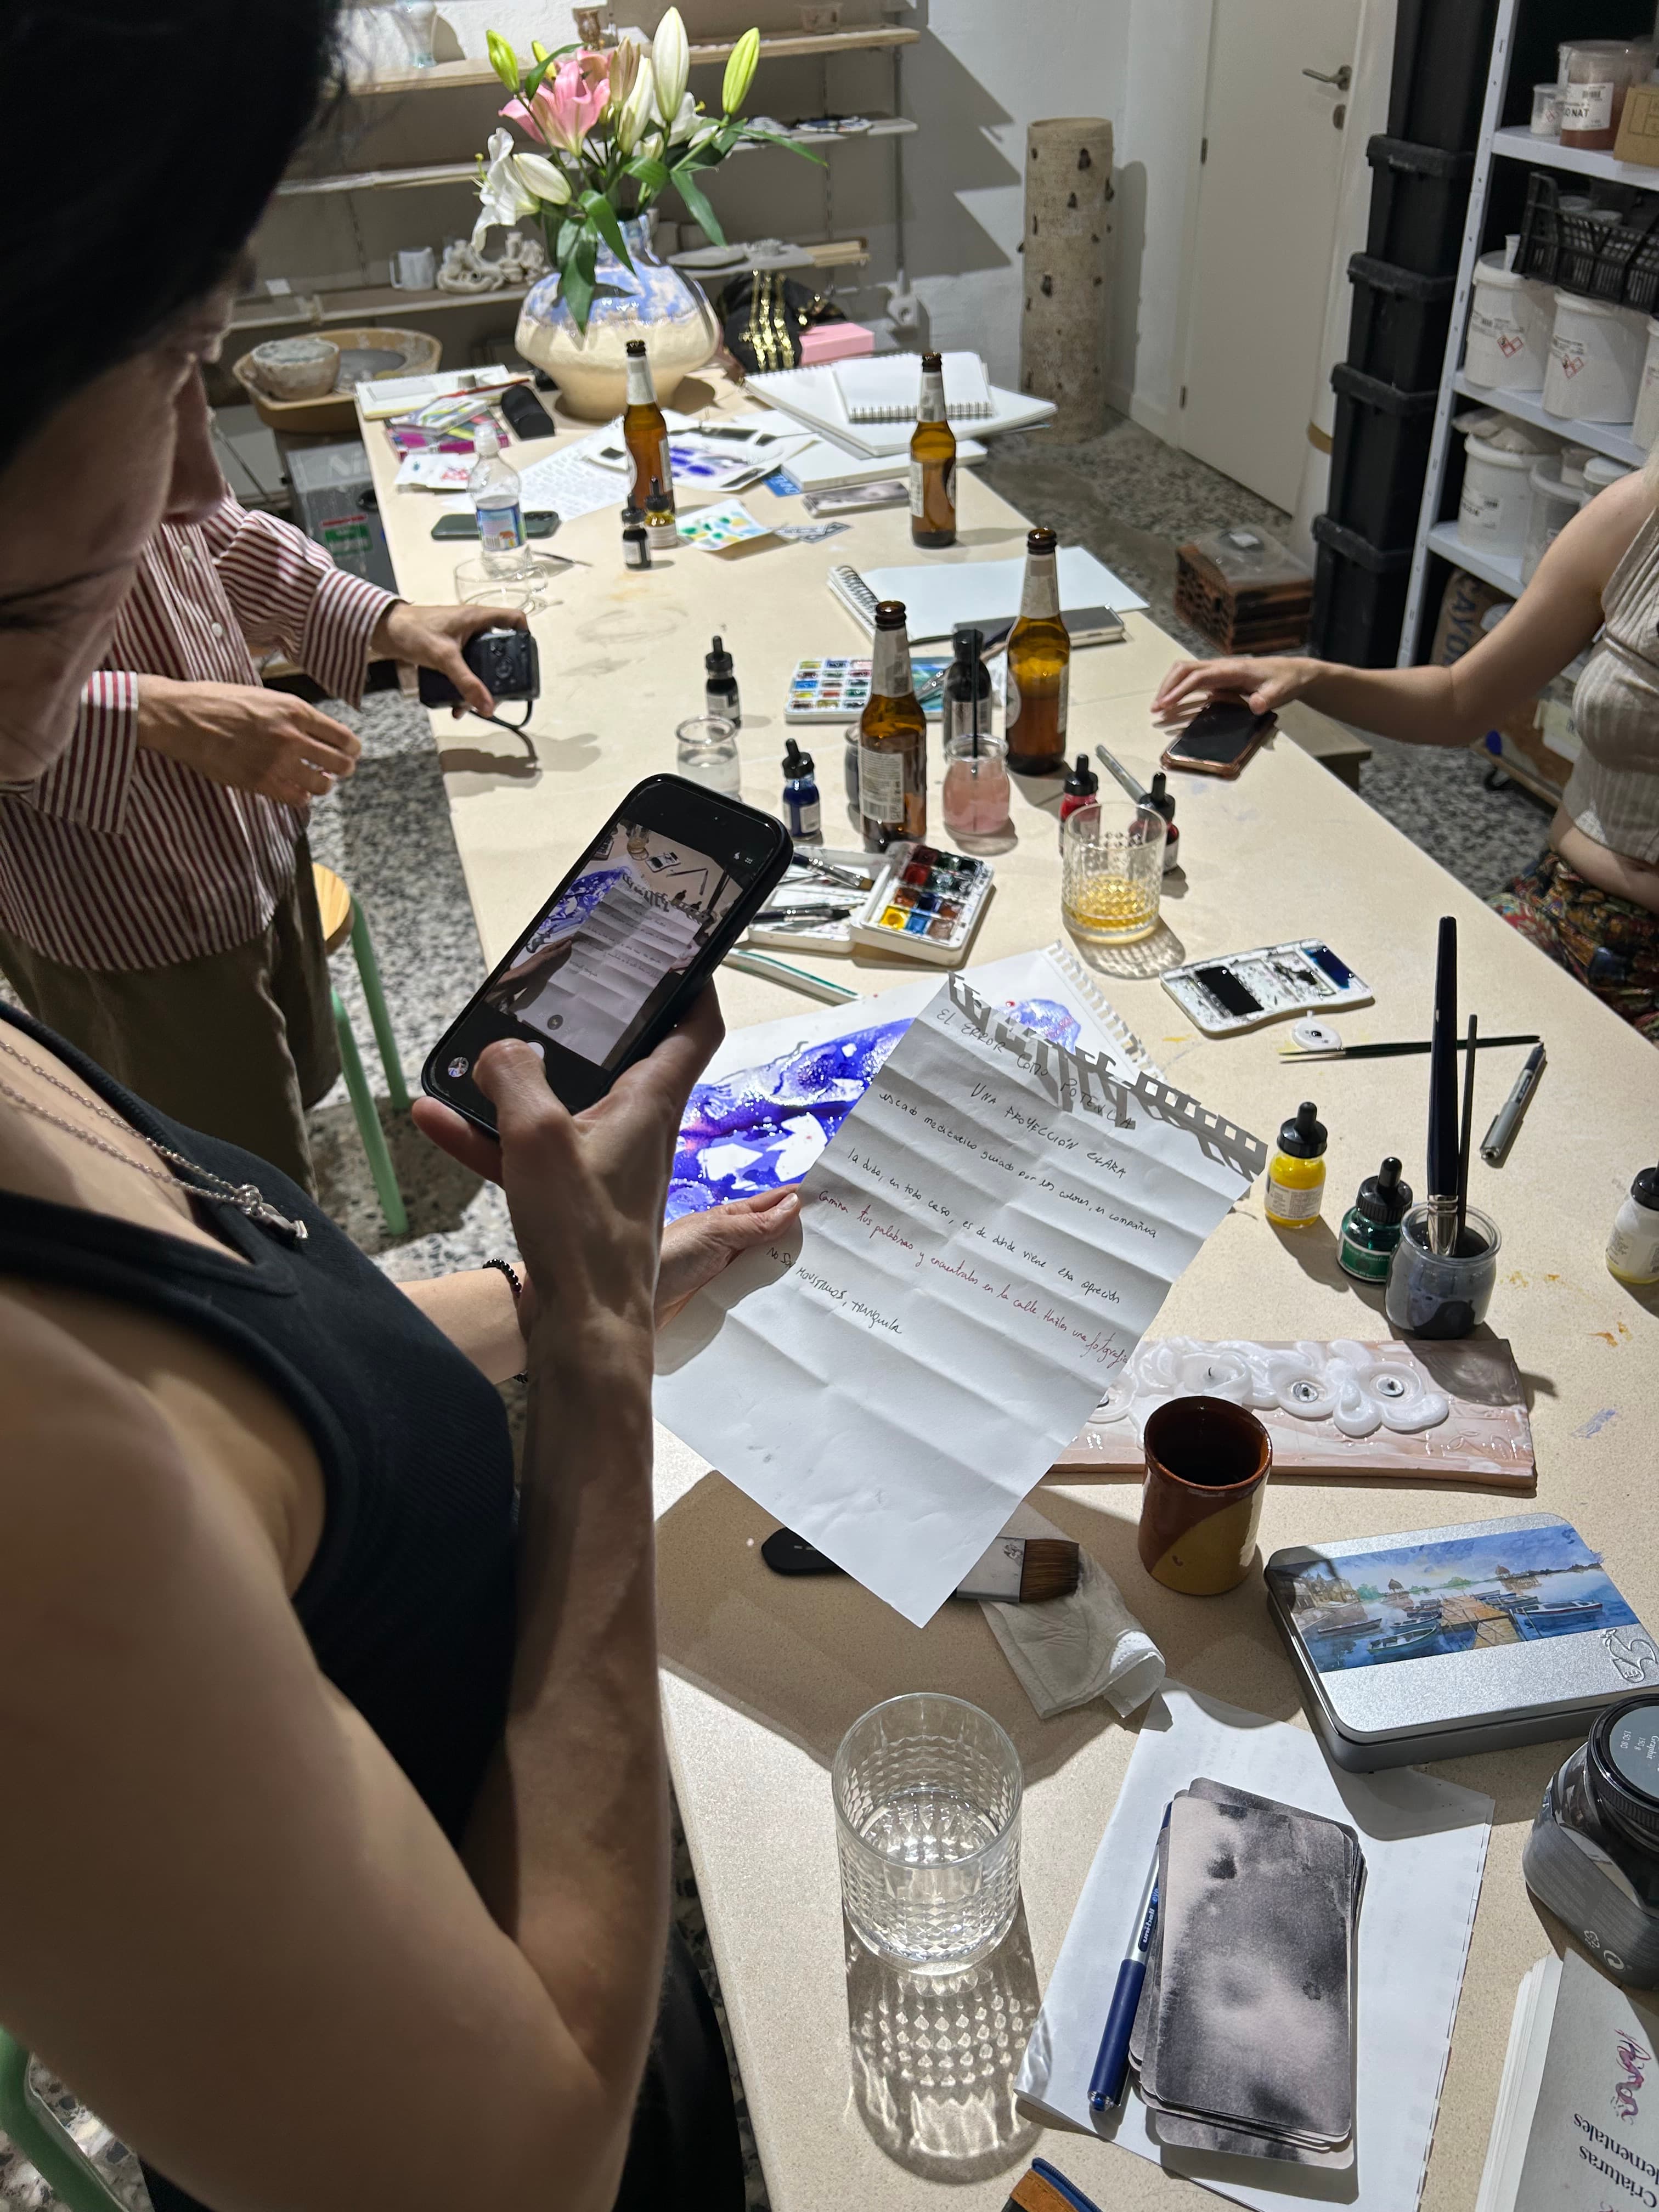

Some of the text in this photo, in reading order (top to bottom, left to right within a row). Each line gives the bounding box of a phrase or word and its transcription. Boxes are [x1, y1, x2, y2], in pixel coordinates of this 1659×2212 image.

[961, 1023, 1006, 1053] ERROR
[970, 1082, 996, 1104] UNA
[1086, 1152, 1127, 1179] CLARA
[1018, 1170, 1037, 1181] por
[904, 1183, 922, 1200] todo
[962, 1220, 974, 1230] es
[976, 1227, 987, 1238] de
[1023, 1250, 1047, 1268] viene
[856, 1204, 873, 1226] tus
[869, 1224, 914, 1250] palabras
[915, 1251, 925, 1268] y
[981, 1283, 994, 1294] en
[996, 1283, 1011, 1300] la
[1071, 1329, 1087, 1341] una
[1623, 1730, 1632, 1741] 150
[1143, 1908, 1155, 1943] uni-ball
[1573, 2113, 1659, 2185] lementales
[1578, 2145, 1657, 2208] Criaturas
